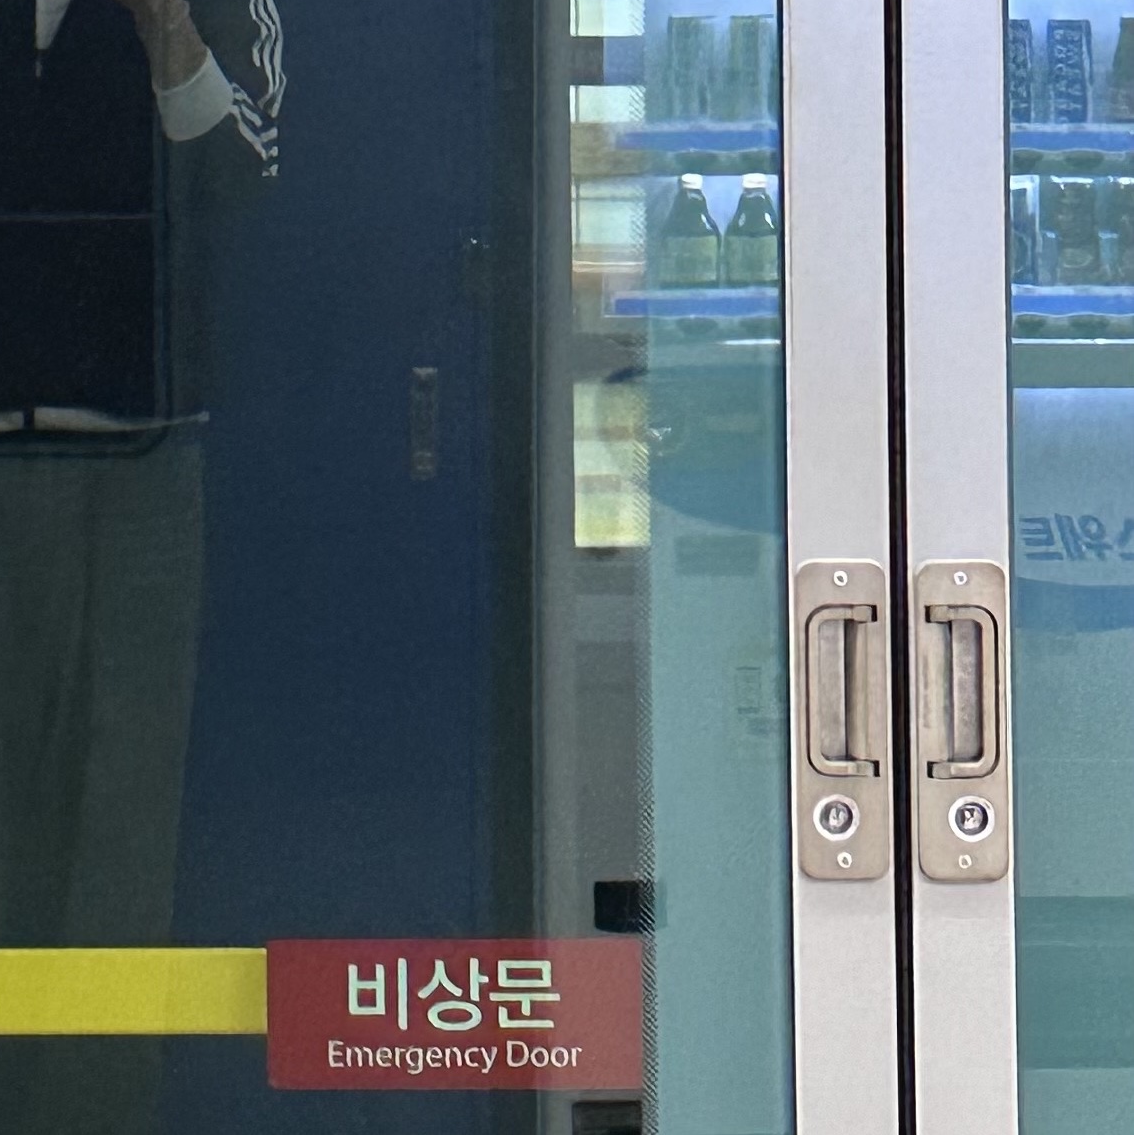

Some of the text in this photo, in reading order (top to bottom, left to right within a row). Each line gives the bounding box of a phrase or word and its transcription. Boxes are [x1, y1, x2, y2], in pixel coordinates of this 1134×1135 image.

[348, 957, 561, 1031] 비상문
[328, 1040, 583, 1075] Emergency Door
